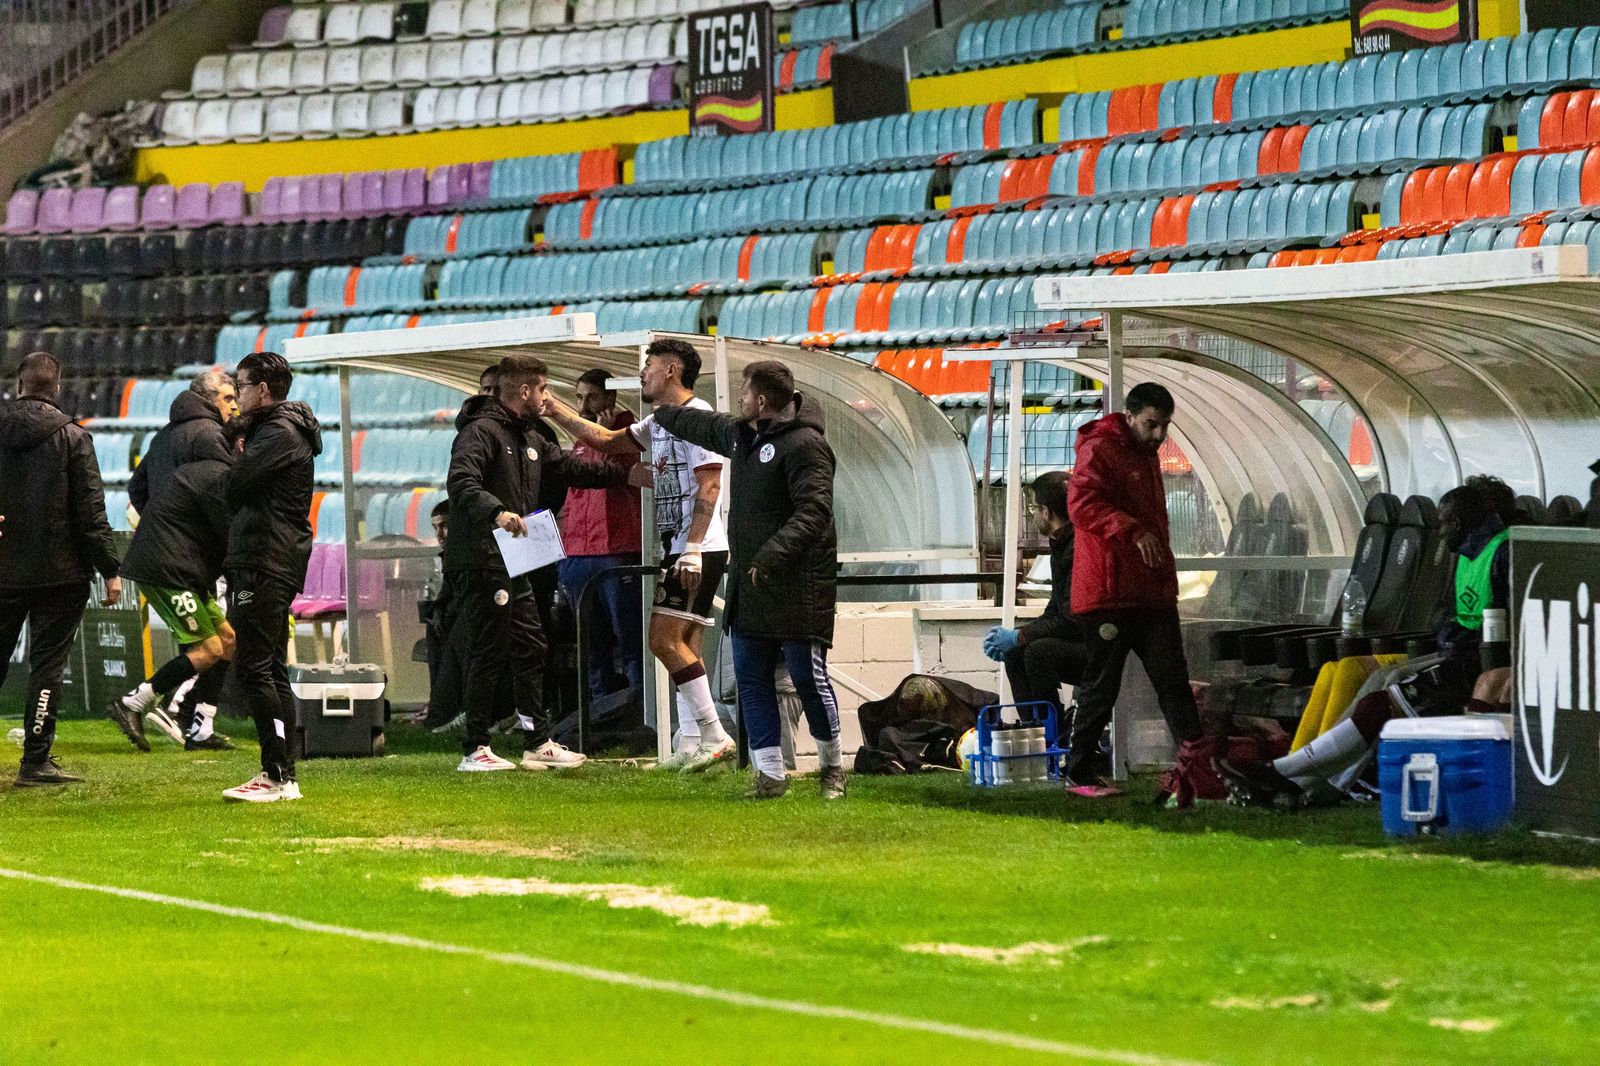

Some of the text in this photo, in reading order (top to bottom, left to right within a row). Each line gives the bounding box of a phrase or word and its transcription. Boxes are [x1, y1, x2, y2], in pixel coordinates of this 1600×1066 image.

[695, 11, 760, 75] TGSA
[171, 591, 198, 617] 26
[33, 689, 51, 735] umbro
